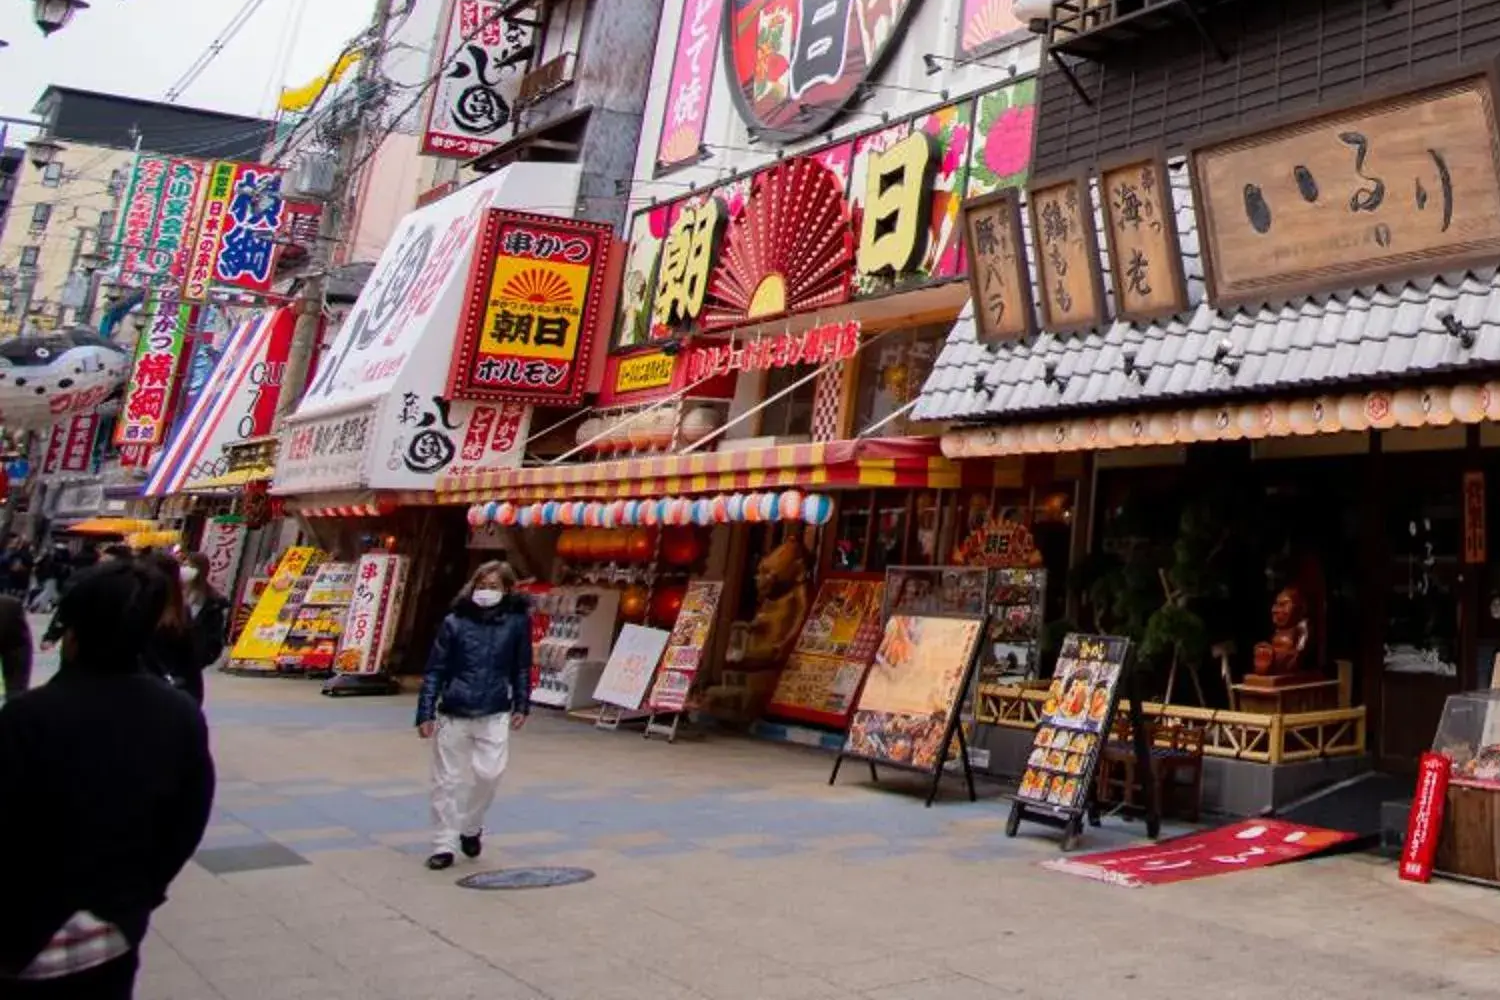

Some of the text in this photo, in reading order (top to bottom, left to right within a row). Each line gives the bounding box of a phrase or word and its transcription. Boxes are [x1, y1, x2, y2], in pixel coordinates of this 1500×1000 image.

[503, 231, 589, 262] 串かつ
[1113, 182, 1152, 297] 海老
[490, 310, 570, 347] 朝日
[476, 357, 569, 387] ホルモン
